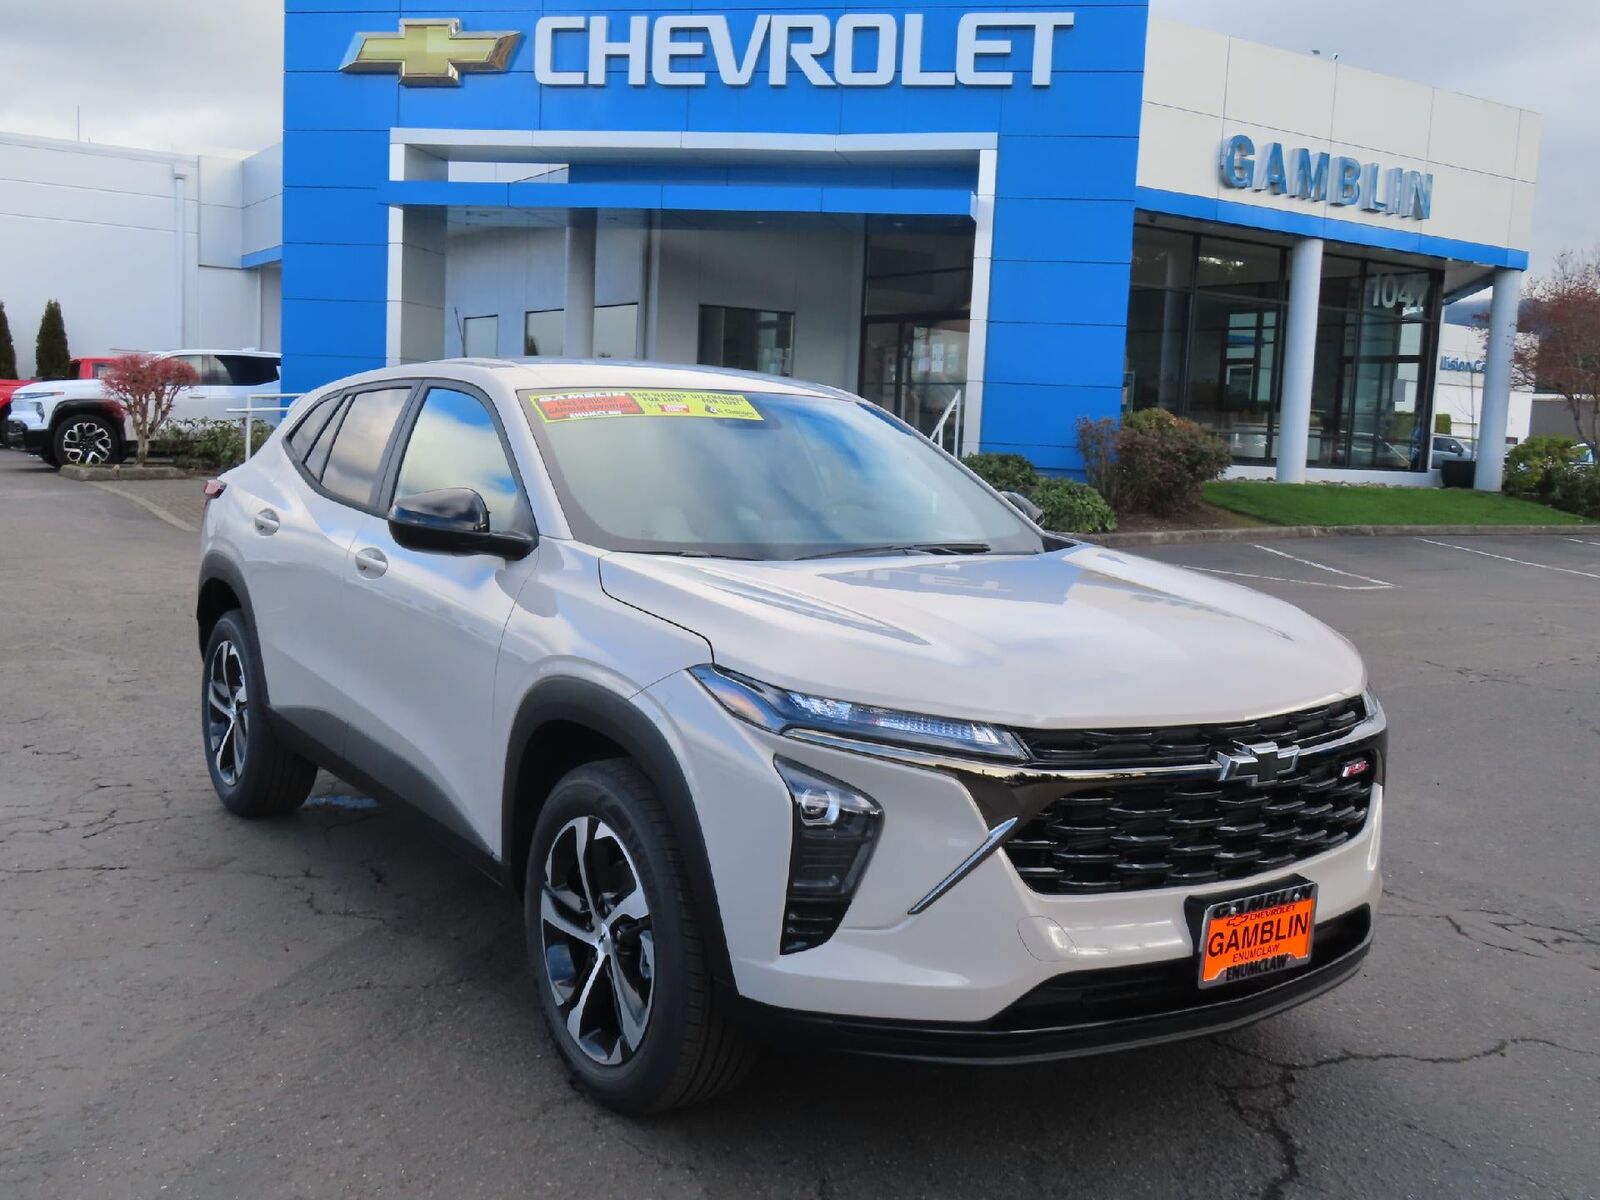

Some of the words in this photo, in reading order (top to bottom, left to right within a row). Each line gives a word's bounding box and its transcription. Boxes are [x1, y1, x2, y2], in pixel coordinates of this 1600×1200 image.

[534, 12, 1075, 87] CHEVROLET
[1220, 134, 1433, 219] GAMBLIN
[1371, 273, 1429, 312] 1047
[1249, 904, 1296, 921] CHEVROLET
[1208, 911, 1310, 957] GAMBLIN
[1232, 943, 1281, 963] ENUMCLAW
[1226, 954, 1288, 981] ENUMCLAW
